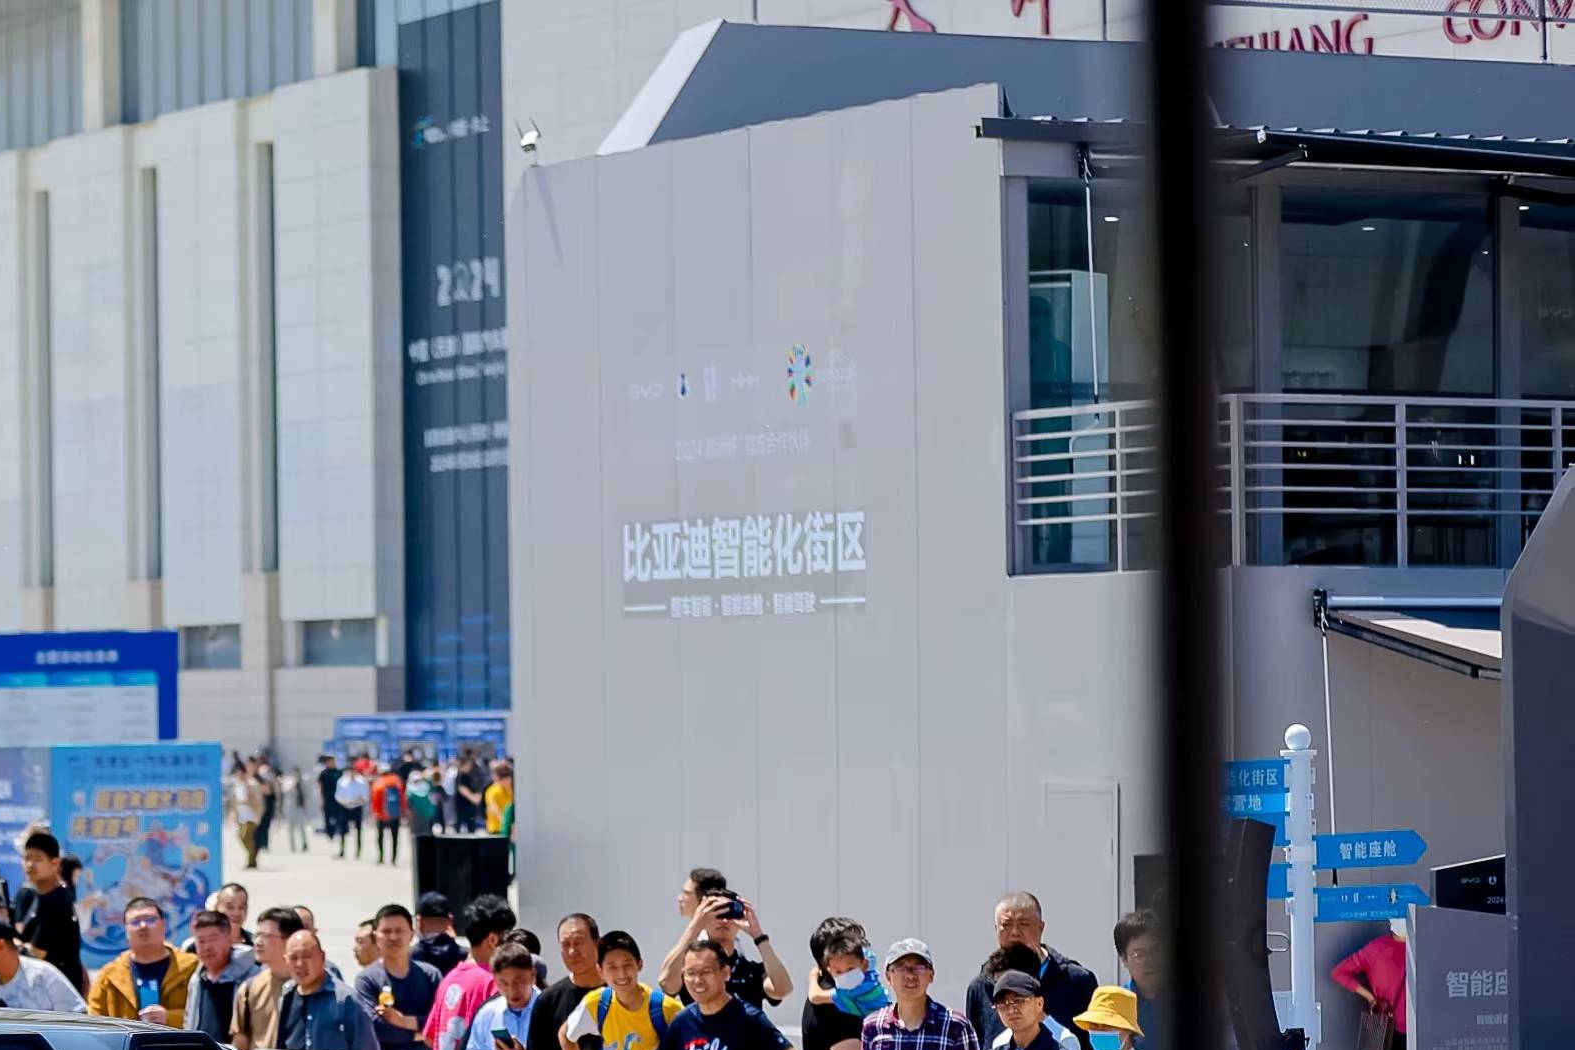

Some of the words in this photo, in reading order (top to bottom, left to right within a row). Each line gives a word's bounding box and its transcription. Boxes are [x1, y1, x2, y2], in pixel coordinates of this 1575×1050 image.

[623, 511, 866, 582] 比亚迪智能化街区
[1224, 794, 1262, 812] 营地
[1339, 839, 1398, 860] 智能座舱
